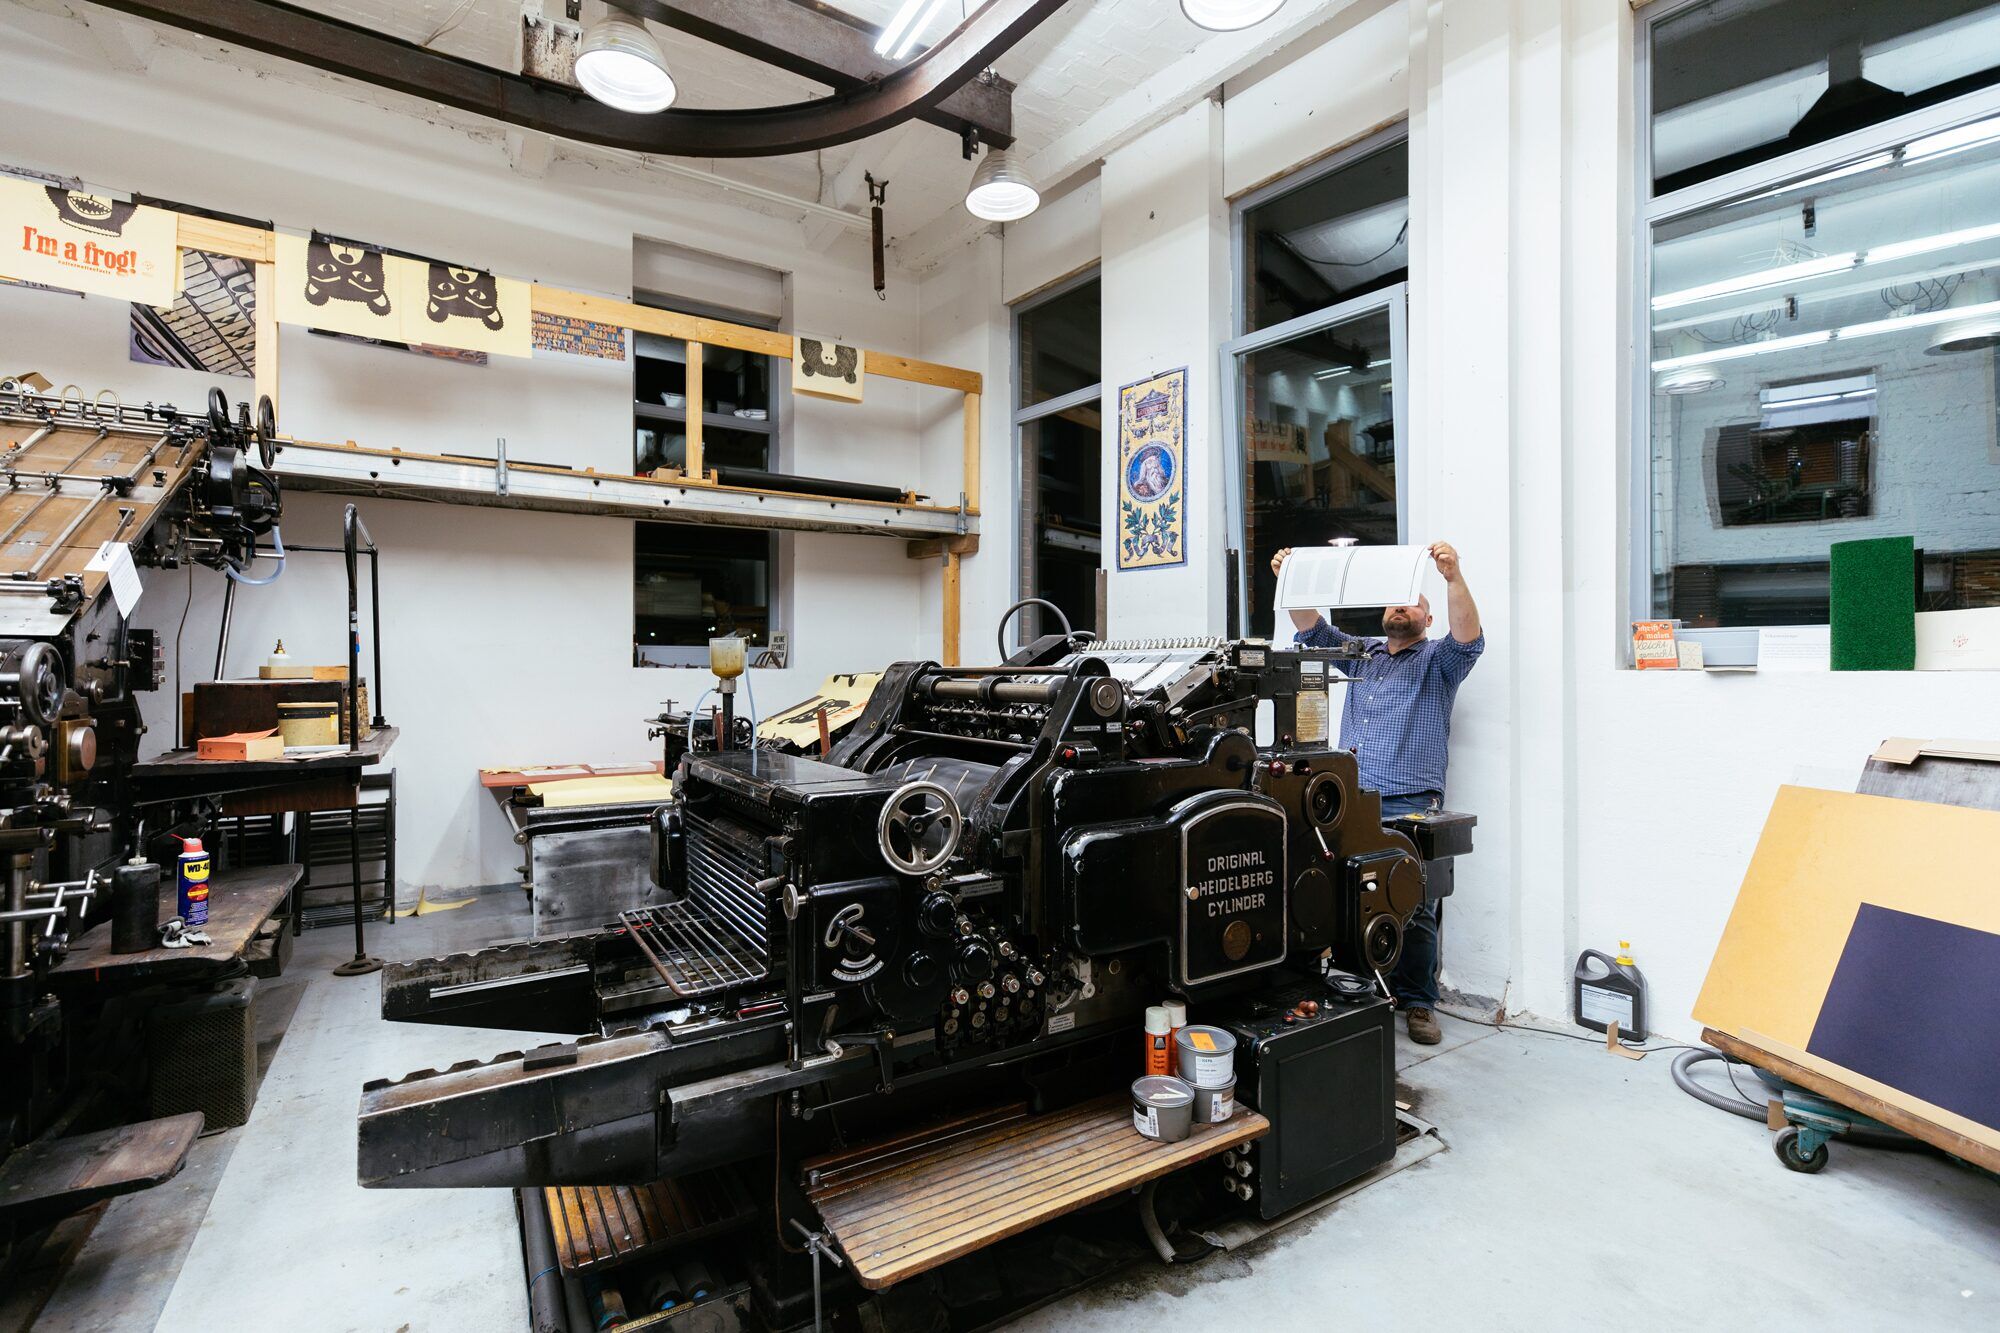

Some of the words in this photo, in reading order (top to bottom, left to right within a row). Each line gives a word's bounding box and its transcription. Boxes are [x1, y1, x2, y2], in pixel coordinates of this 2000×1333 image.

[64, 241, 78, 262] a
[83, 241, 137, 274] frog!
[1207, 850, 1266, 873] ORIGINAL
[1199, 870, 1274, 897] HEIDELBERG
[1207, 892, 1266, 918] CYLINDER
